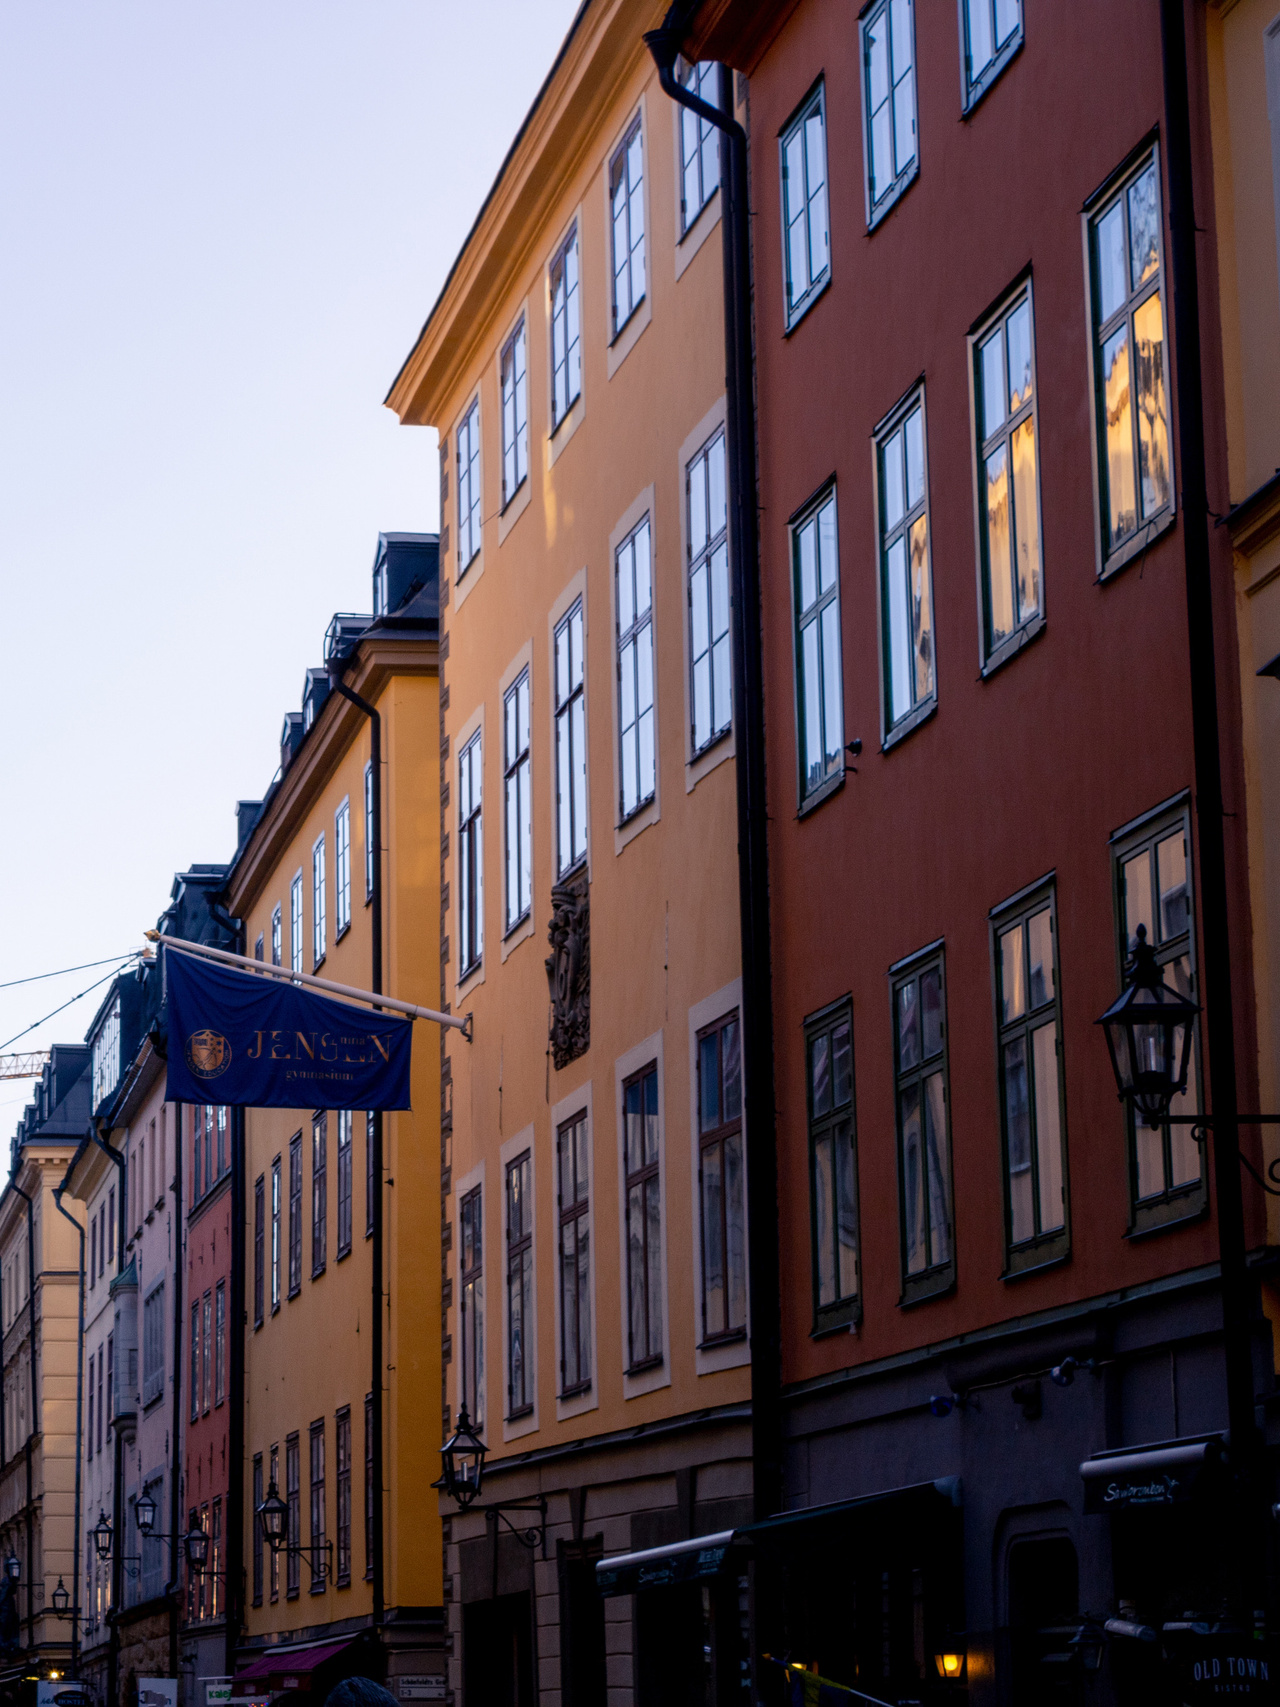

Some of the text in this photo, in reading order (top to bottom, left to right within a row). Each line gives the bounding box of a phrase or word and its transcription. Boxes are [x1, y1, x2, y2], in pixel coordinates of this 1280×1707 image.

[285, 1069, 355, 1082] gymnasium
[1193, 1657, 1269, 1681] OLD TOWN
[208, 1689, 231, 1701] Kalej
